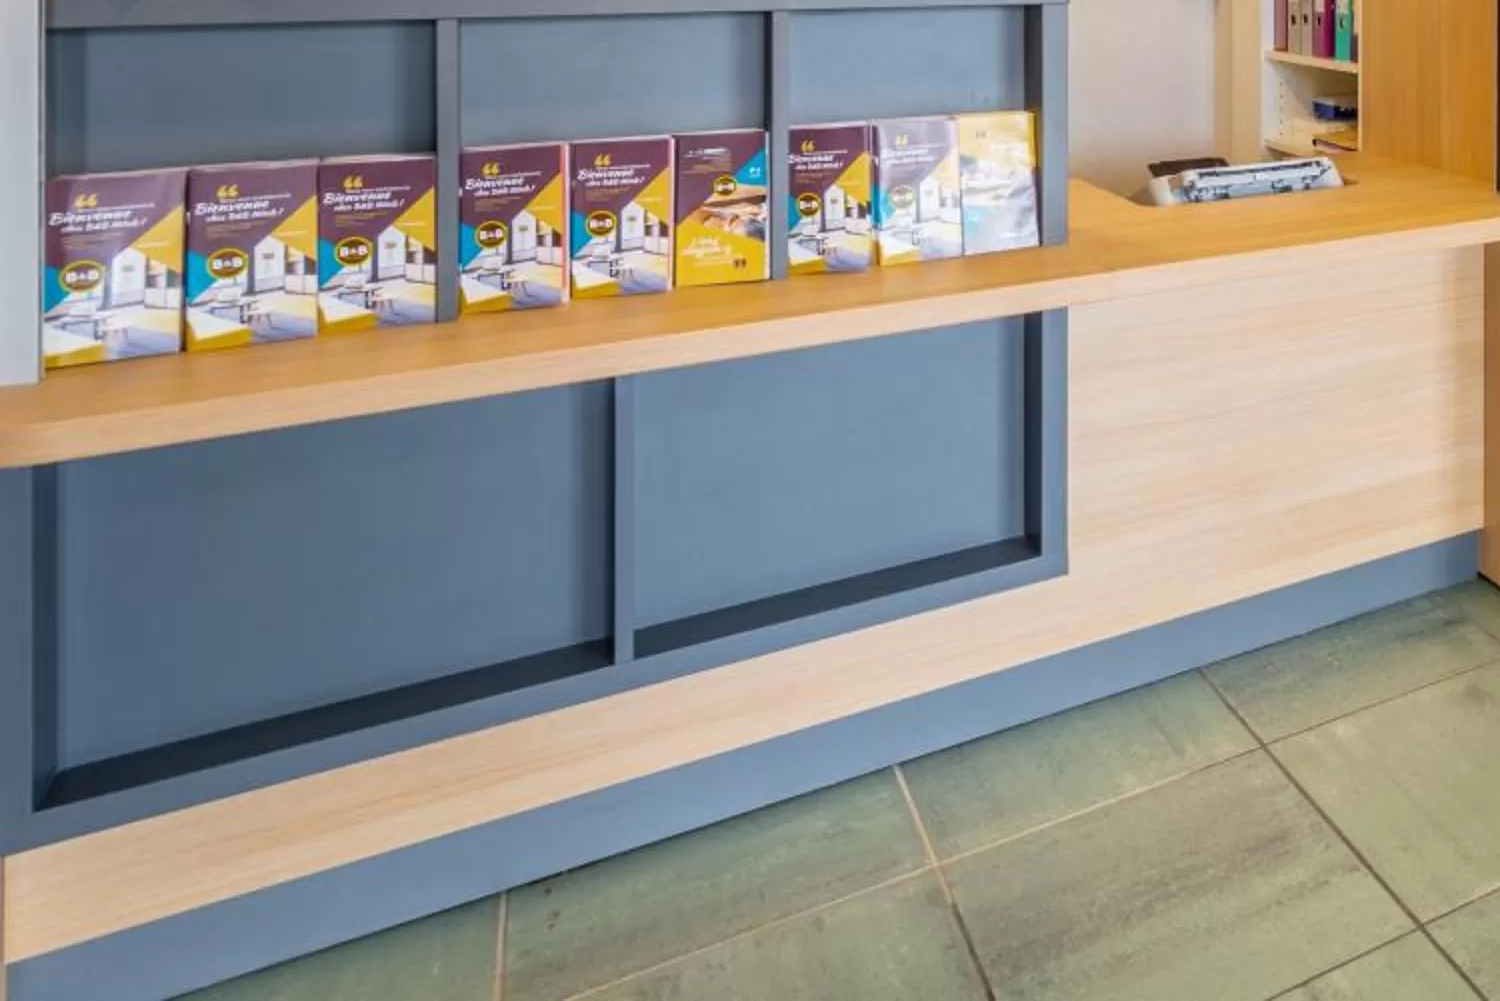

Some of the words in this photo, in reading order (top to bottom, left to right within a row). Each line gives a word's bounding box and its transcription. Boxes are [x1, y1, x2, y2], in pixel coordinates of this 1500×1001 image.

[322, 190, 392, 205] Bienvenue
[193, 199, 270, 216] Bienvenue
[48, 209, 132, 226] Bienvenue
